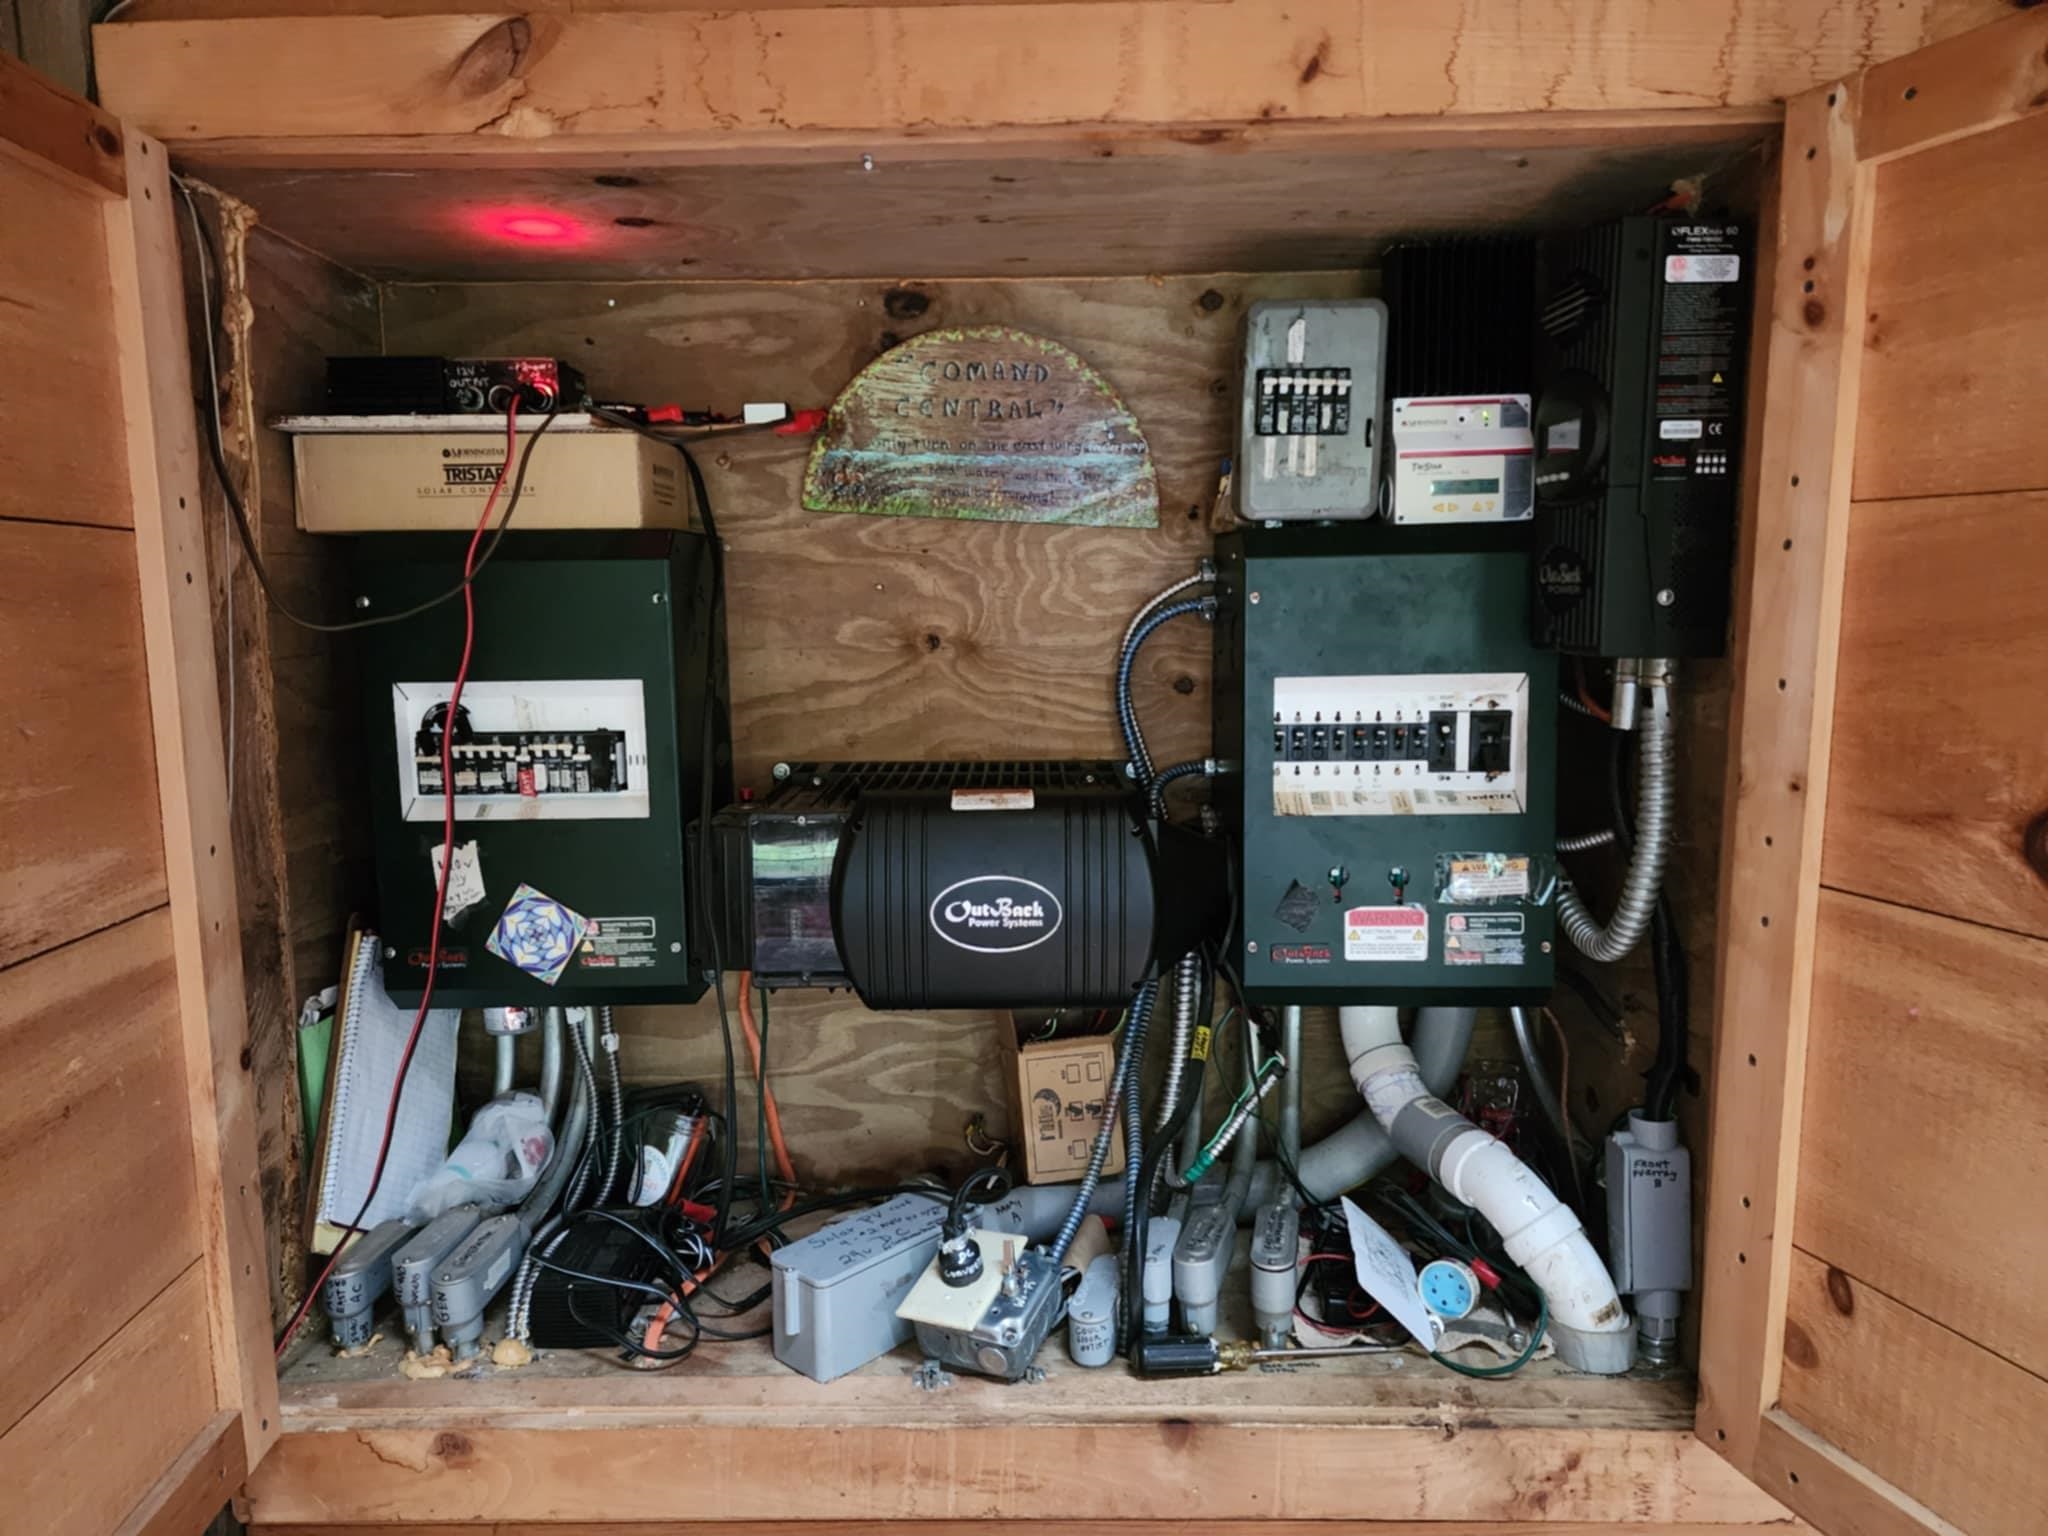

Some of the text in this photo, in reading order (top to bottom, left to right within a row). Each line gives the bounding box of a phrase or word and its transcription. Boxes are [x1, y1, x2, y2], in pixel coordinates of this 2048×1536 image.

[944, 897, 1044, 923] OutBack
[968, 917, 1044, 930] Power Systems
[438, 1291, 450, 1323] GEN
